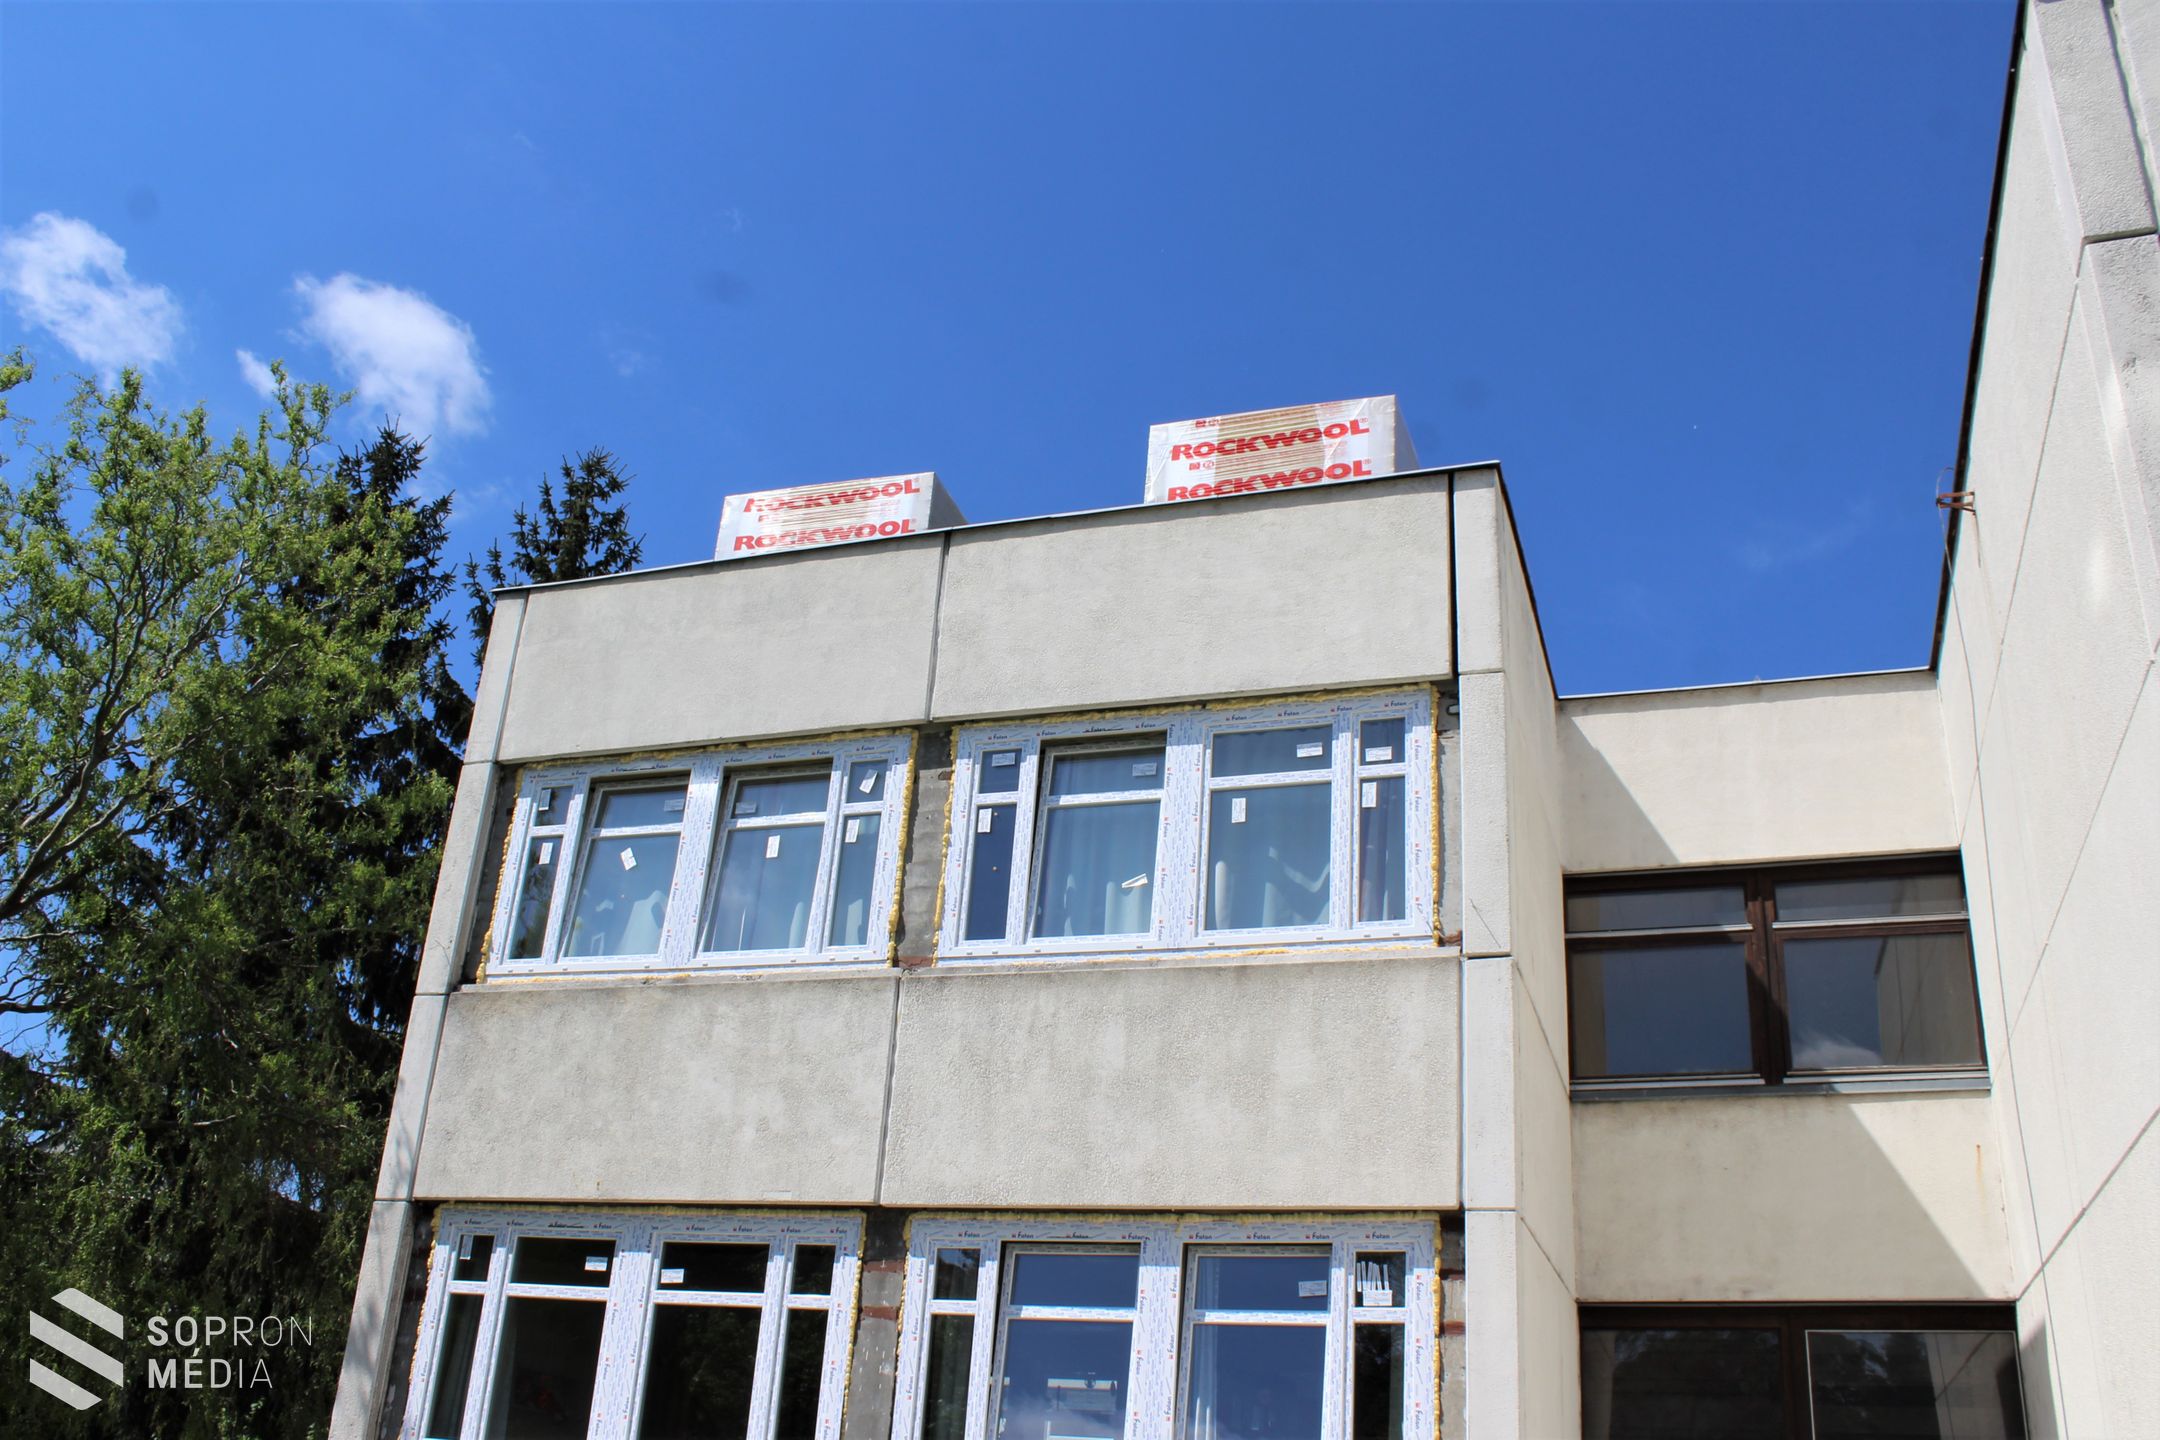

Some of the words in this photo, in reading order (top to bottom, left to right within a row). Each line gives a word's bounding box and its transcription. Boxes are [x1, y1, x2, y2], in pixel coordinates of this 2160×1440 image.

[1171, 419, 1370, 461] ROCKWOOL
[1167, 460, 1372, 502] ROCKWOOL
[733, 519, 917, 552] ROCKWOOL
